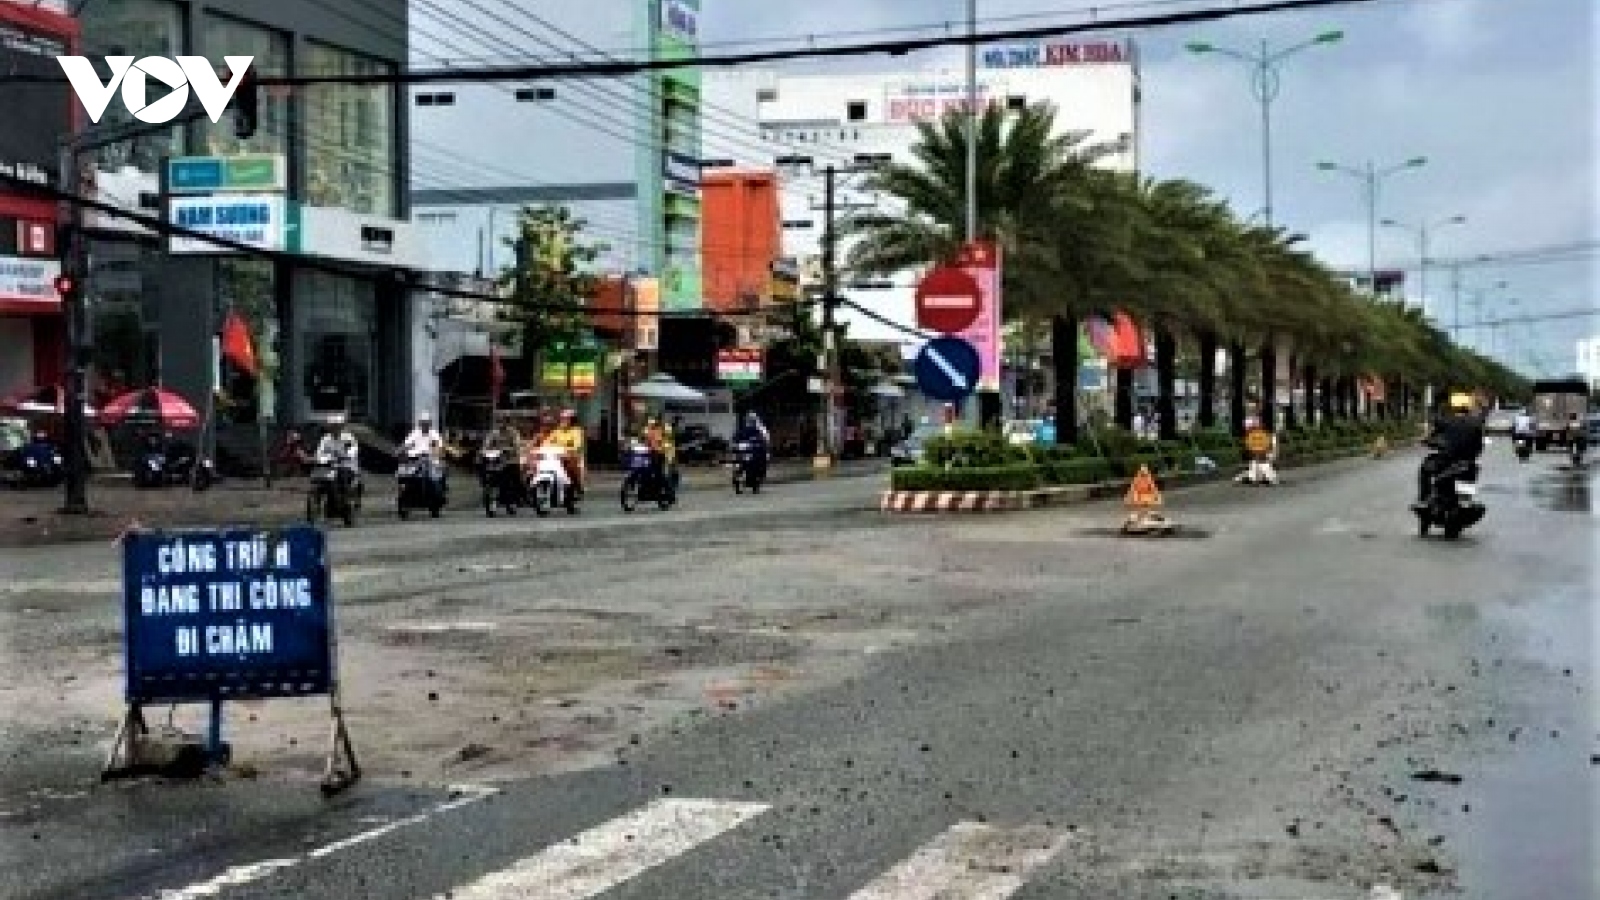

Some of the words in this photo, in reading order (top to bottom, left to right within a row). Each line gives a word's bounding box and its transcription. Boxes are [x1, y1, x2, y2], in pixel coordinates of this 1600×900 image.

[158, 539, 217, 573] CÔNG
[207, 582, 243, 611] THI
[249, 574, 312, 610] CÔNG
